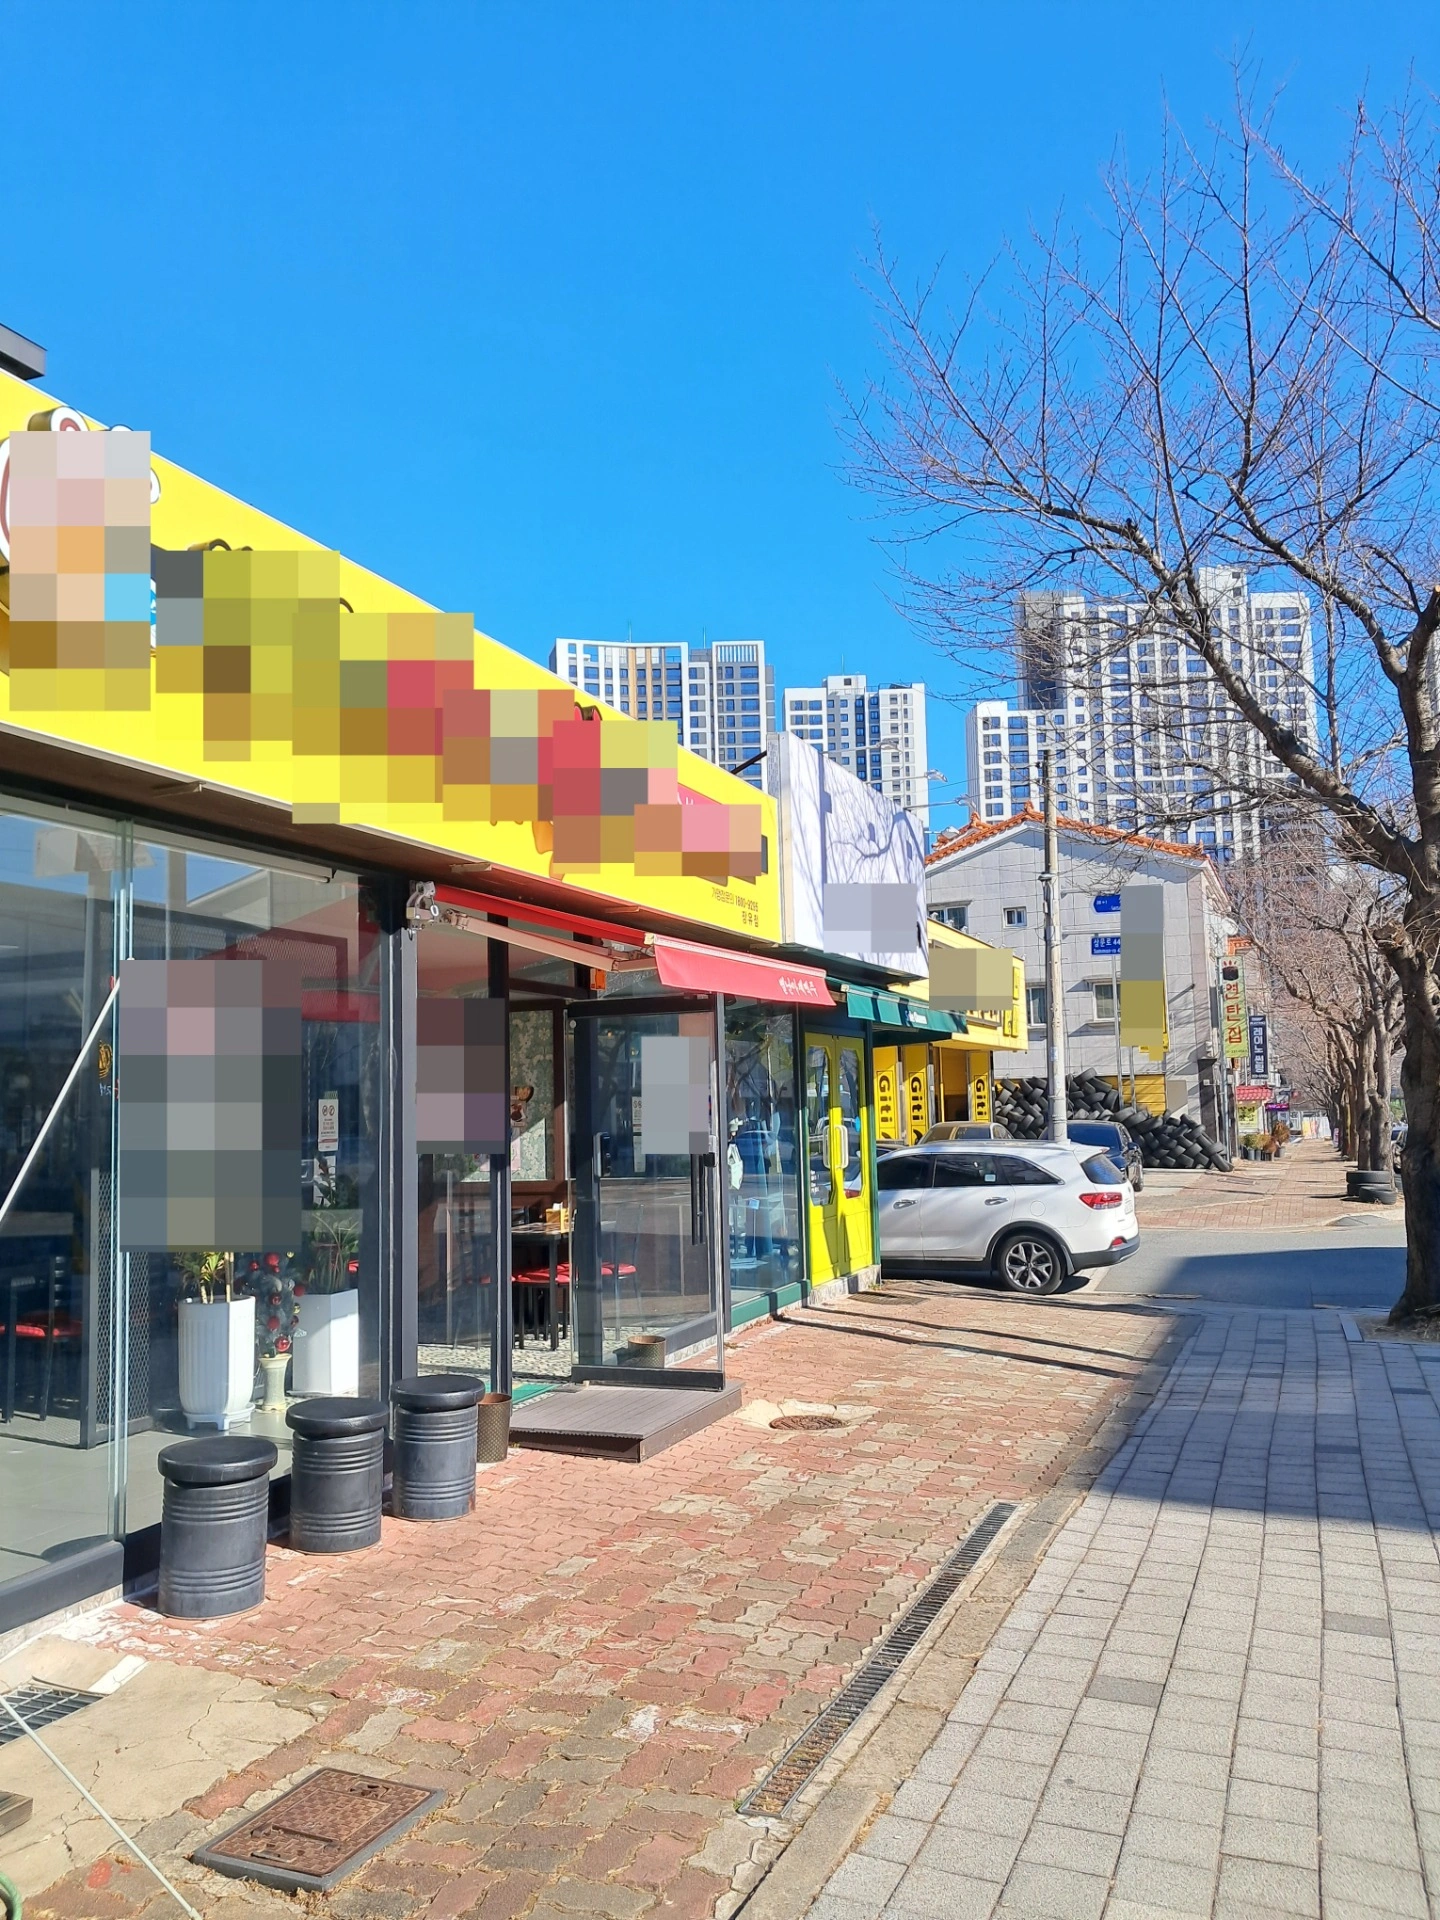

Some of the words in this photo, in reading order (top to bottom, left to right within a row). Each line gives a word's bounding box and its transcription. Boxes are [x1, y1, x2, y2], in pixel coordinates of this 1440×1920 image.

[1093, 938, 1112, 947] 삼문로
[1225, 983, 1242, 1044] 연탄집
[1253, 1027, 1264, 1053] 레이노
[879, 1075, 893, 1122] Giti
[911, 1076, 924, 1121] Giti
[975, 1078, 987, 1116] Giti
